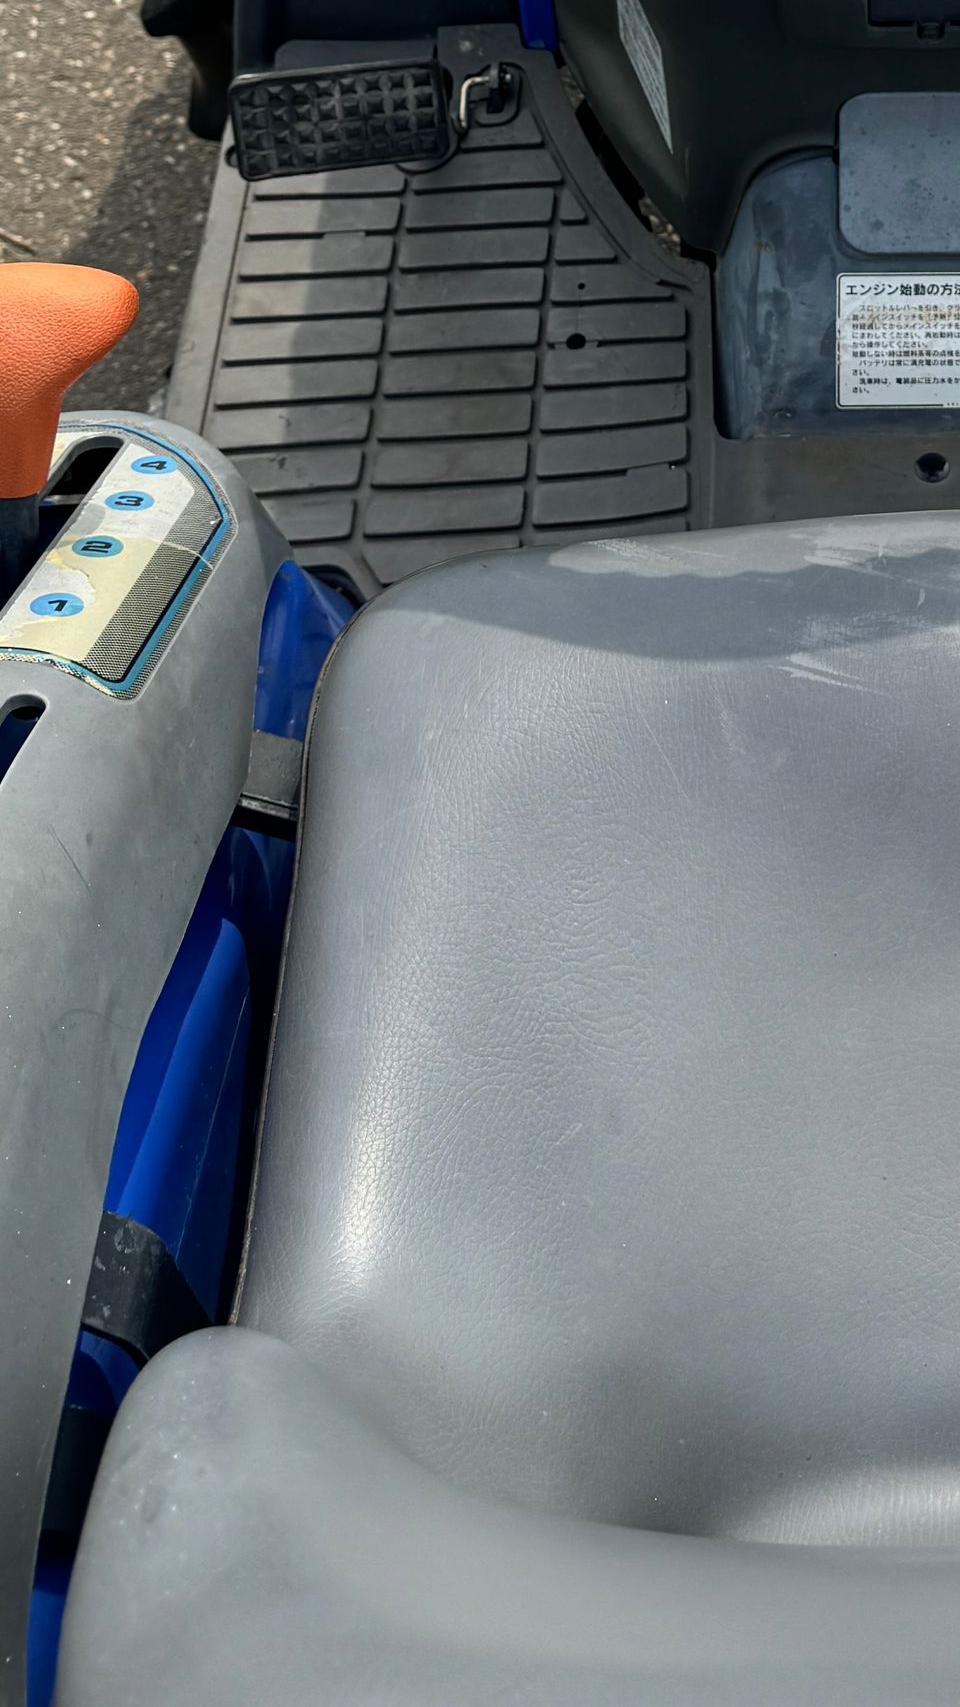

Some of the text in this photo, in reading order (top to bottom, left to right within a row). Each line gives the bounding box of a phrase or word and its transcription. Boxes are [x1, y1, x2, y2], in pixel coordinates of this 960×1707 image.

[141, 460, 167, 471] 4
[114, 495, 143, 507] 3
[81, 541, 112, 553] 2
[47, 599, 68, 612] 1
